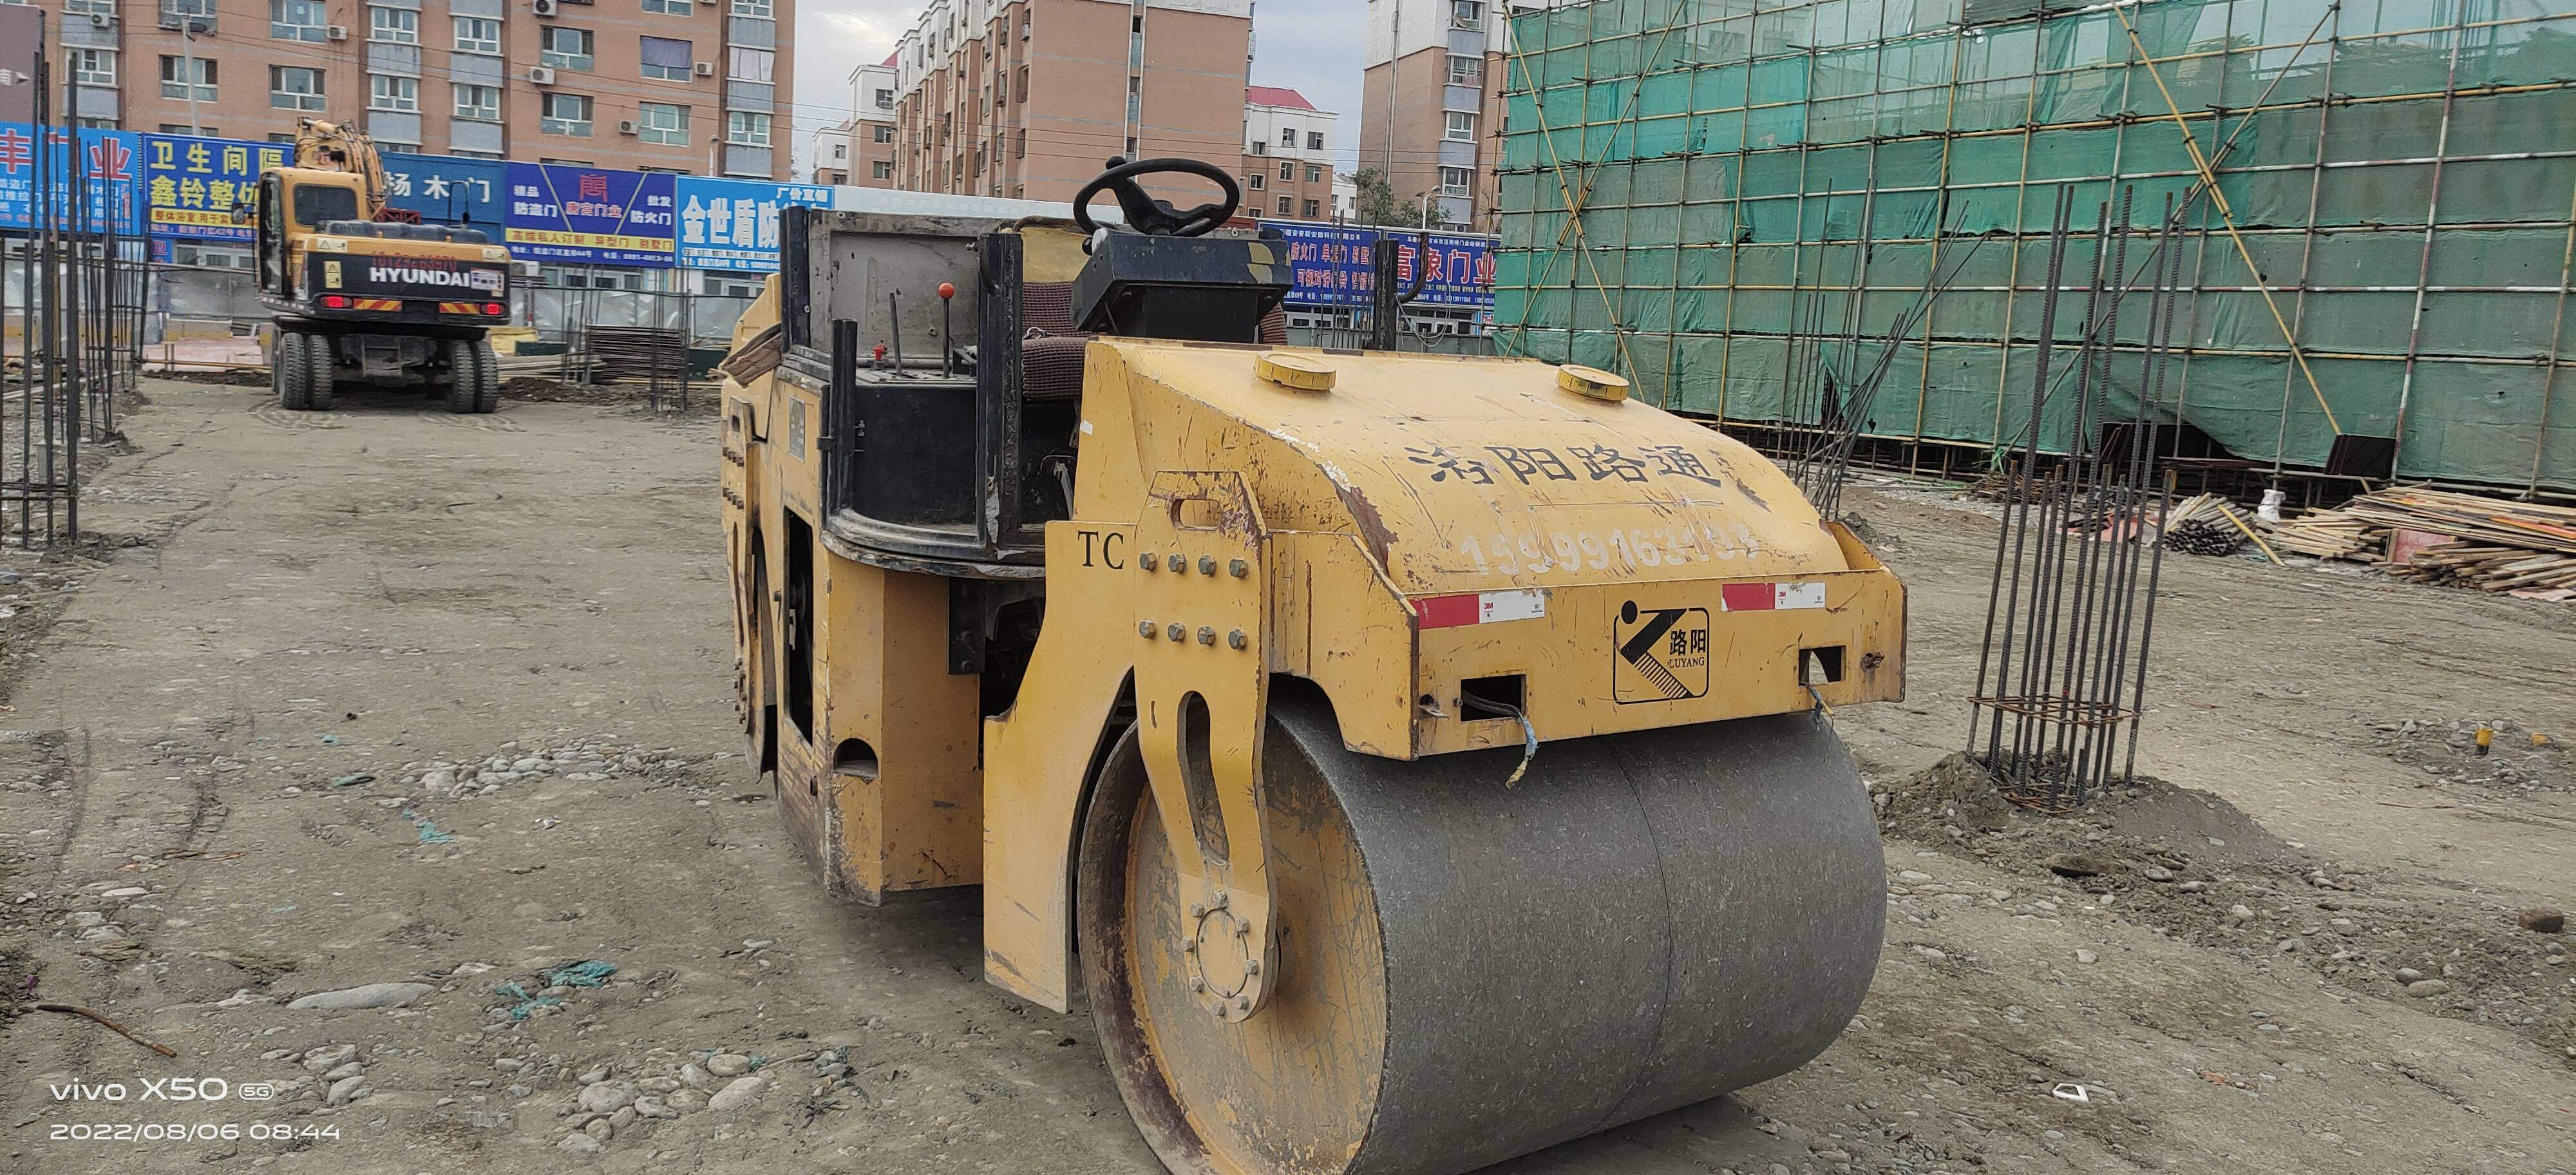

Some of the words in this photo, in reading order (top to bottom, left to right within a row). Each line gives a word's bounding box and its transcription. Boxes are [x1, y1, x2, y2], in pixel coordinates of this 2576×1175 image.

[682, 195, 817, 249] 金世盾防
[1291, 242, 1317, 262] 防火门
[370, 267, 470, 287] HYUNDAI
[1077, 530, 1124, 569] TC
[1670, 629, 1706, 656] 路阳
[1669, 657, 1705, 668] LUYANG
